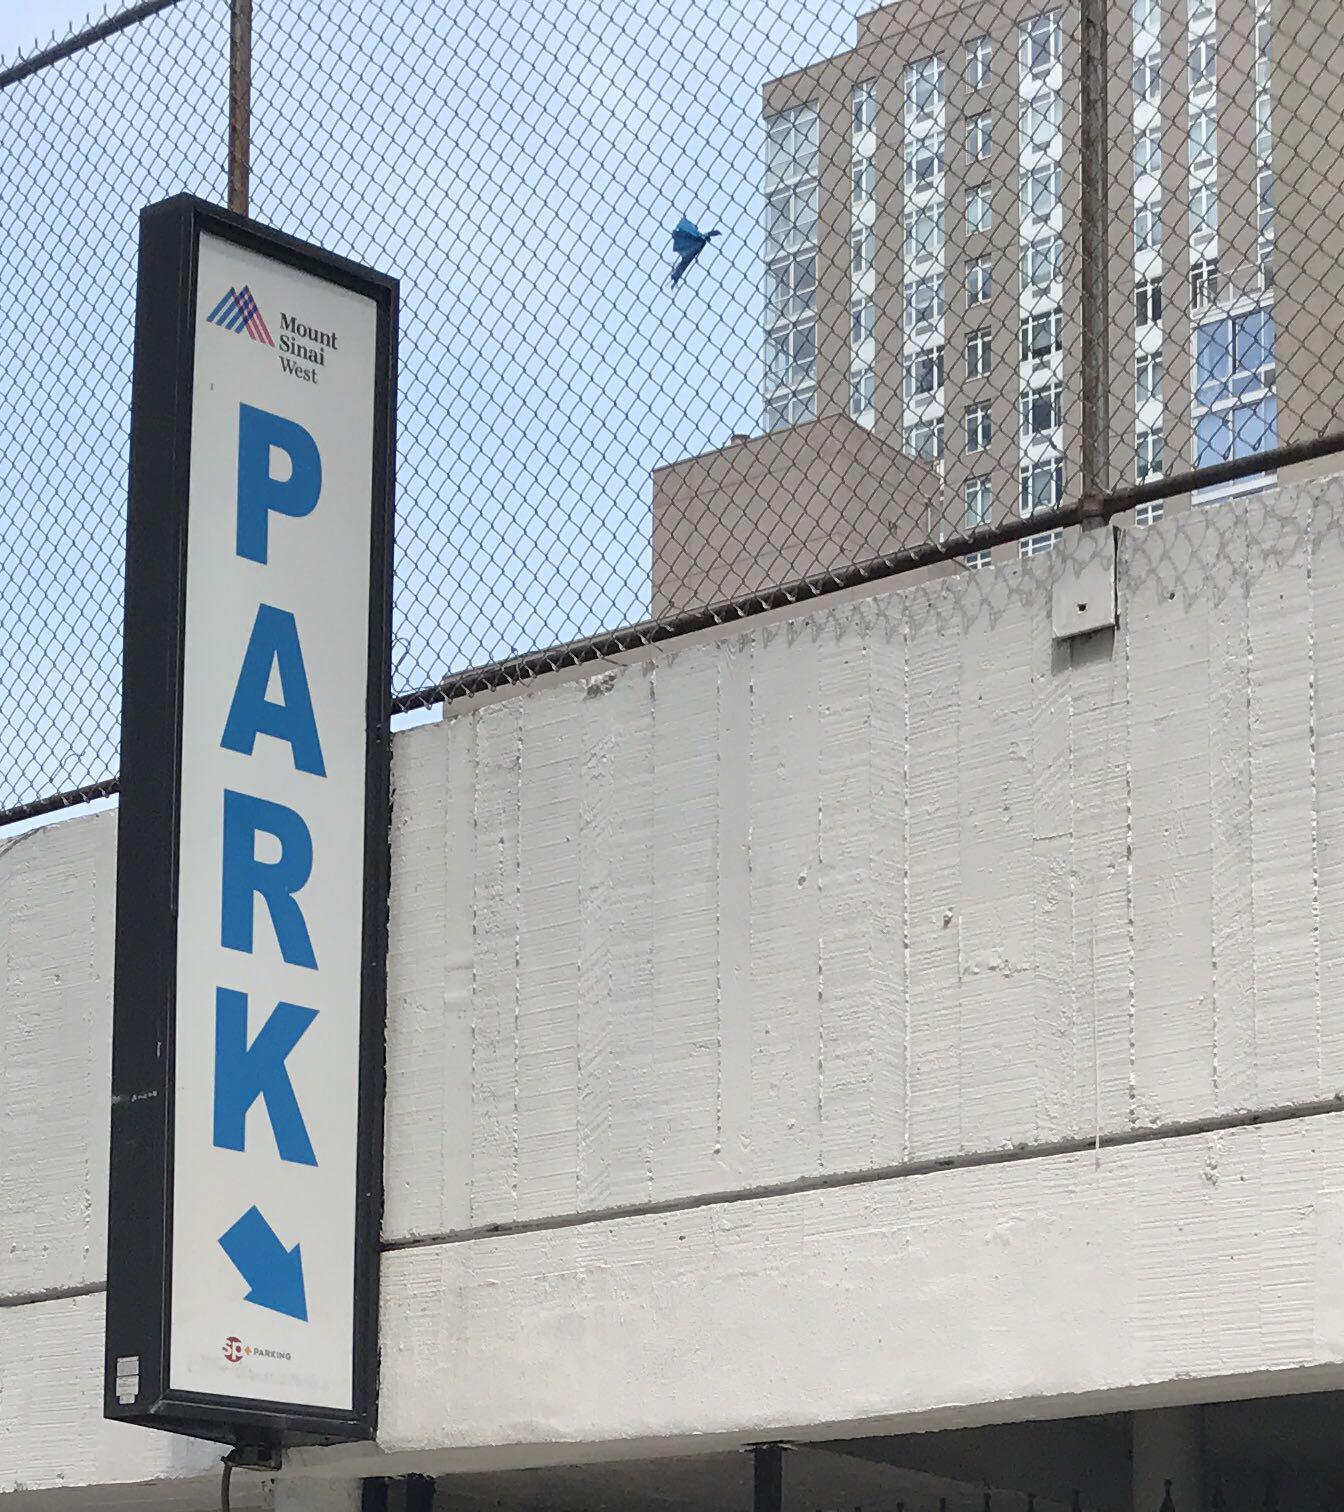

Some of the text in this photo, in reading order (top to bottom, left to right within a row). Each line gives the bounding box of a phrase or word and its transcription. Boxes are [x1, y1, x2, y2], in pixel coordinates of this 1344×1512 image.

[280, 312, 338, 350] Mount
[279, 334, 325, 366] Sinai
[279, 355, 318, 384] West
[213, 402, 327, 1168] PARK
[253, 1347, 291, 1361] PARKING
